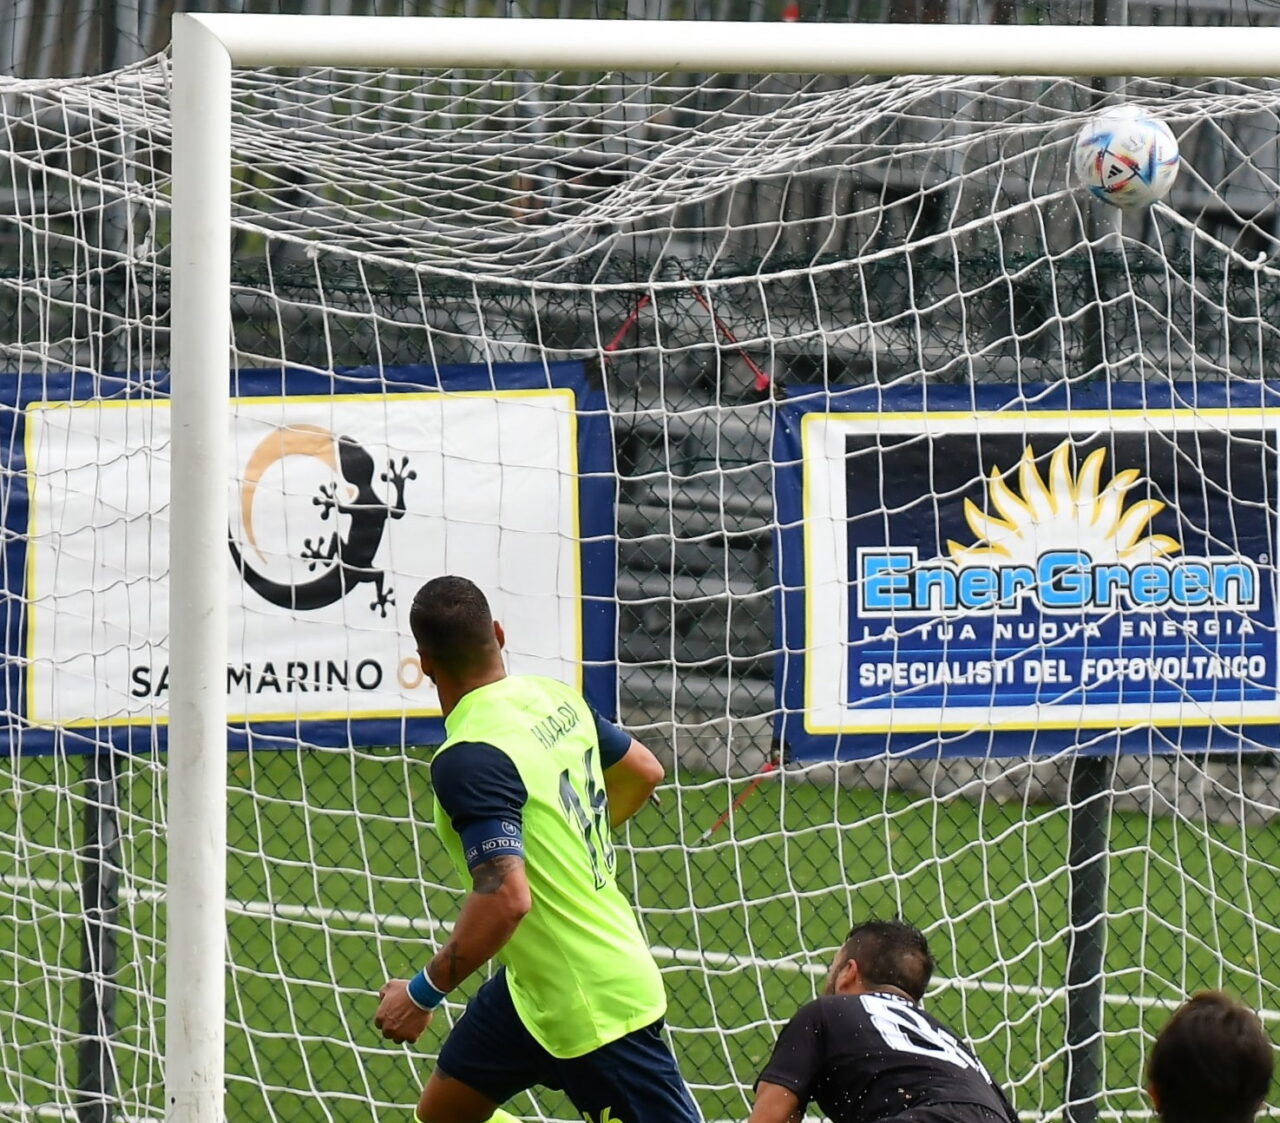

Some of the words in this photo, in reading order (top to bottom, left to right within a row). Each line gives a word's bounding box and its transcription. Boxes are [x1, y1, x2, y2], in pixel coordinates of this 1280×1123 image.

[856, 548, 1260, 617] EnerGreen
[862, 625, 896, 642] LA
[918, 622, 977, 641] TUA
[994, 621, 1101, 640] NUOVA
[1120, 617, 1255, 637] ENERGIA
[131, 665, 170, 698] SA
[226, 657, 384, 695] MARINO
[858, 659, 1015, 687] SPECIALISTI
[1023, 658, 1073, 684] DEL
[1080, 654, 1267, 683] FOTOVOLTAICO
